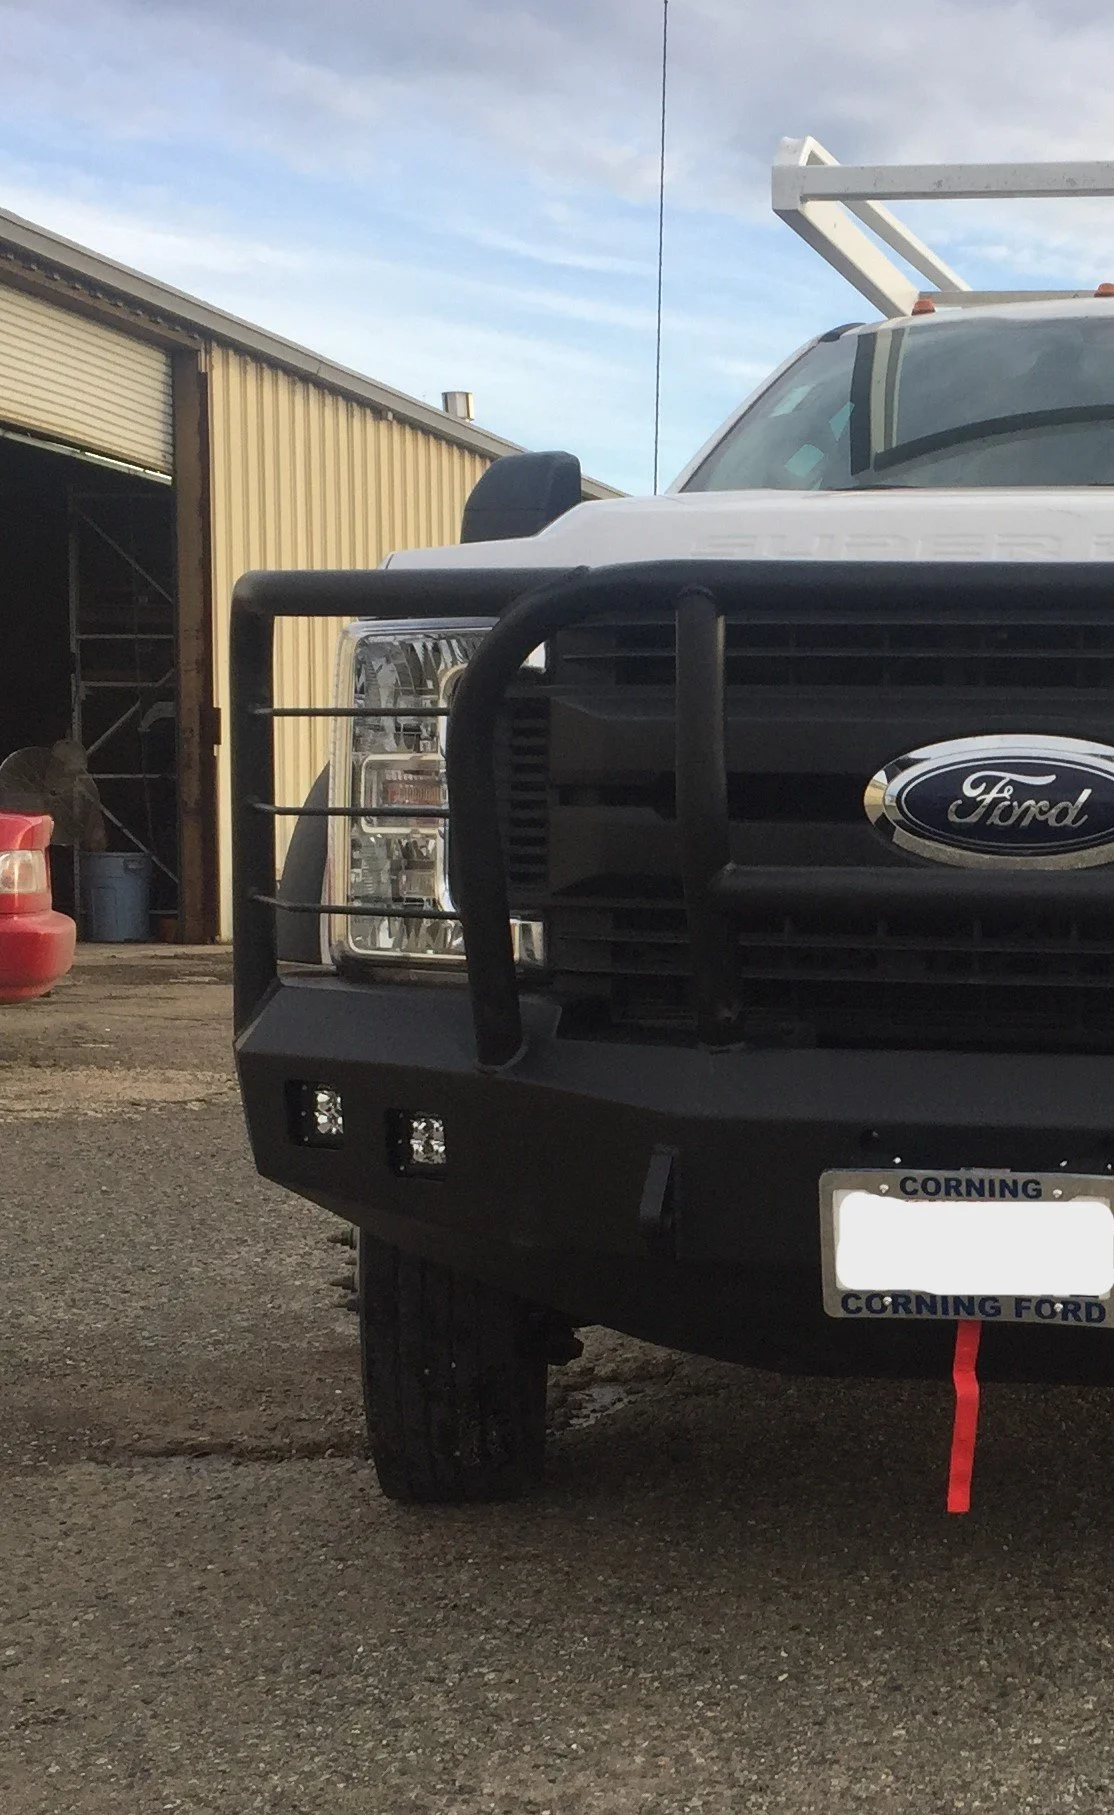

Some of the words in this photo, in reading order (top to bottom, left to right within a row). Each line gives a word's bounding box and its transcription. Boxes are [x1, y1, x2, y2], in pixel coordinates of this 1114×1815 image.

[691, 533, 1068, 561] SUPER
[948, 770, 1092, 828] Ford
[900, 1176, 1042, 1199] CORNING
[841, 1292, 1001, 1318] CORNING
[1014, 1297, 1106, 1324] FORD
